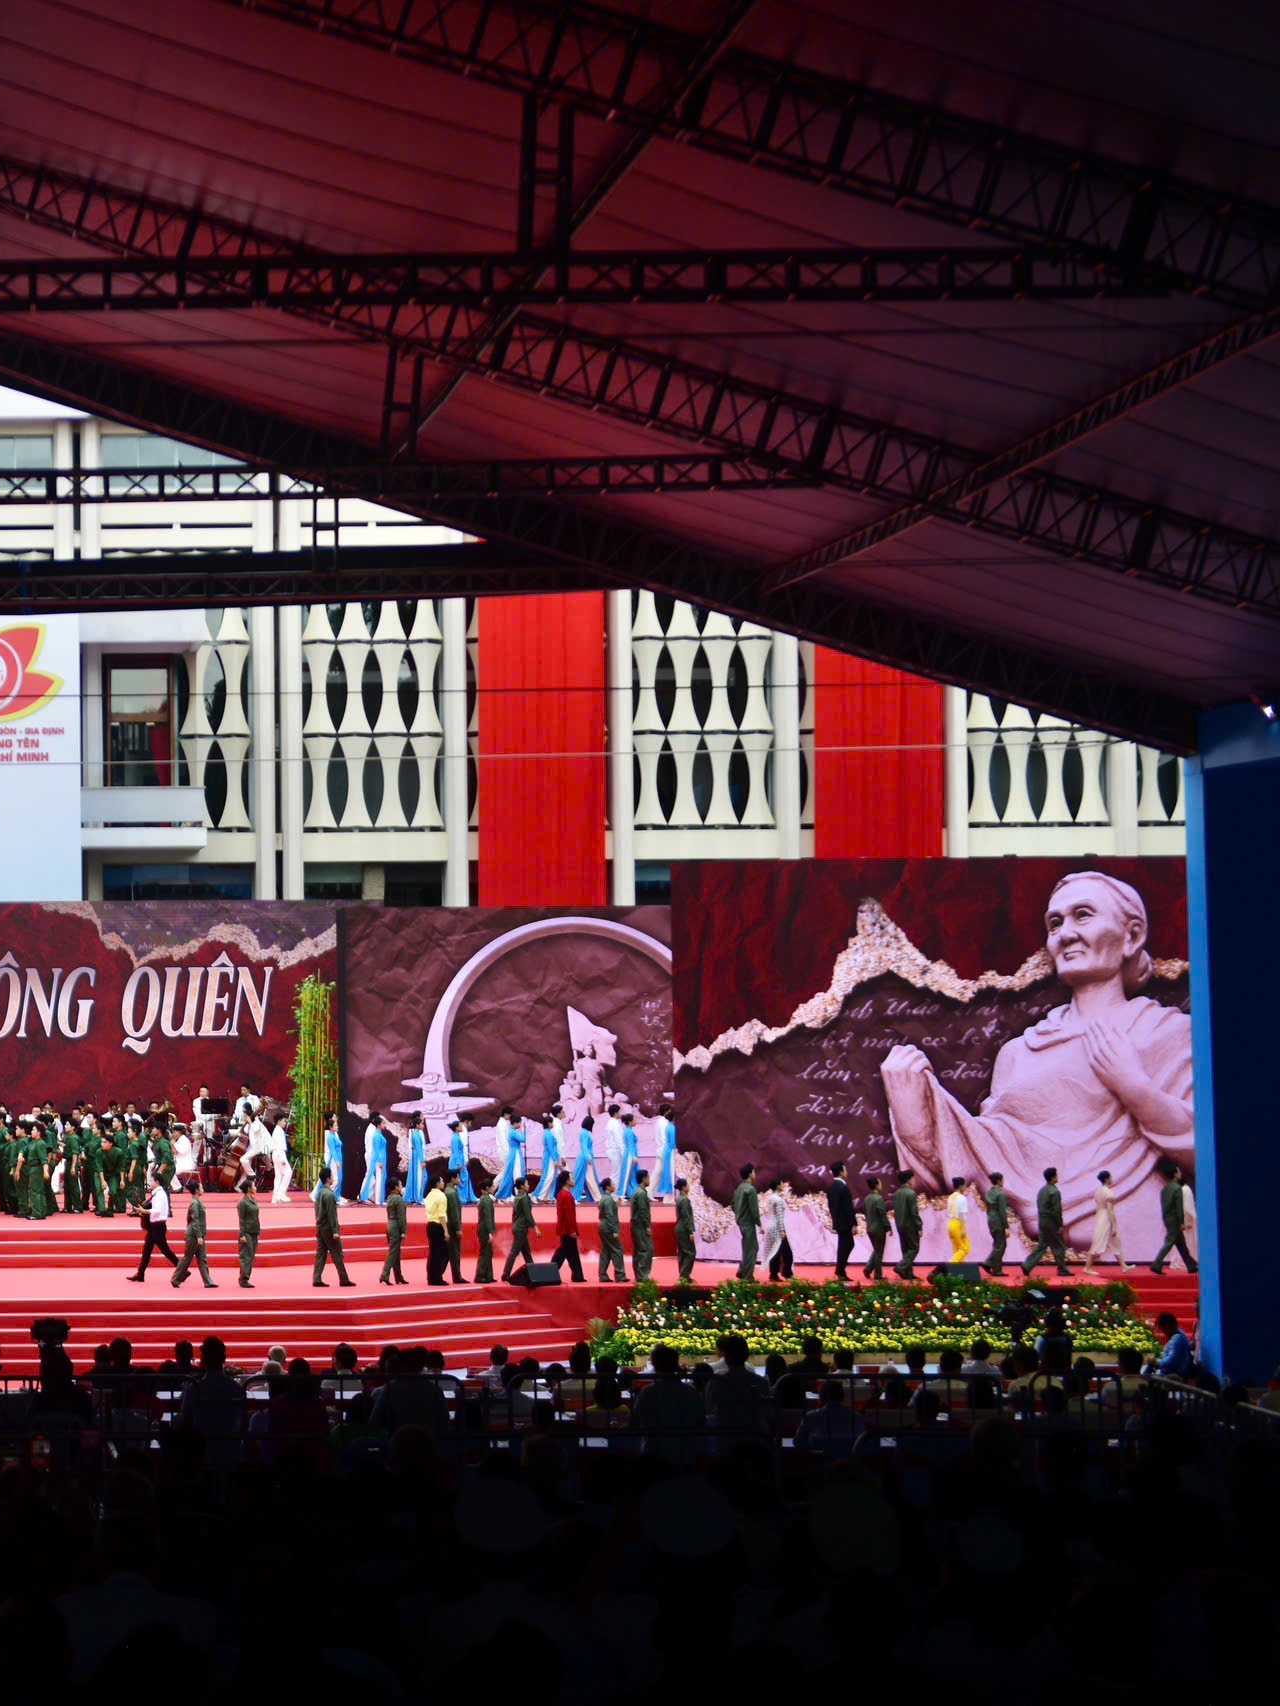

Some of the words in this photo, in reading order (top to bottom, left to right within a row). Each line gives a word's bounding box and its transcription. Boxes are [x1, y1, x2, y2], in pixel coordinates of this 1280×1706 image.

[16, 736, 40, 748] TÊN
[16, 752, 49, 762] MINH
[119, 950, 275, 1056] QUÊN
